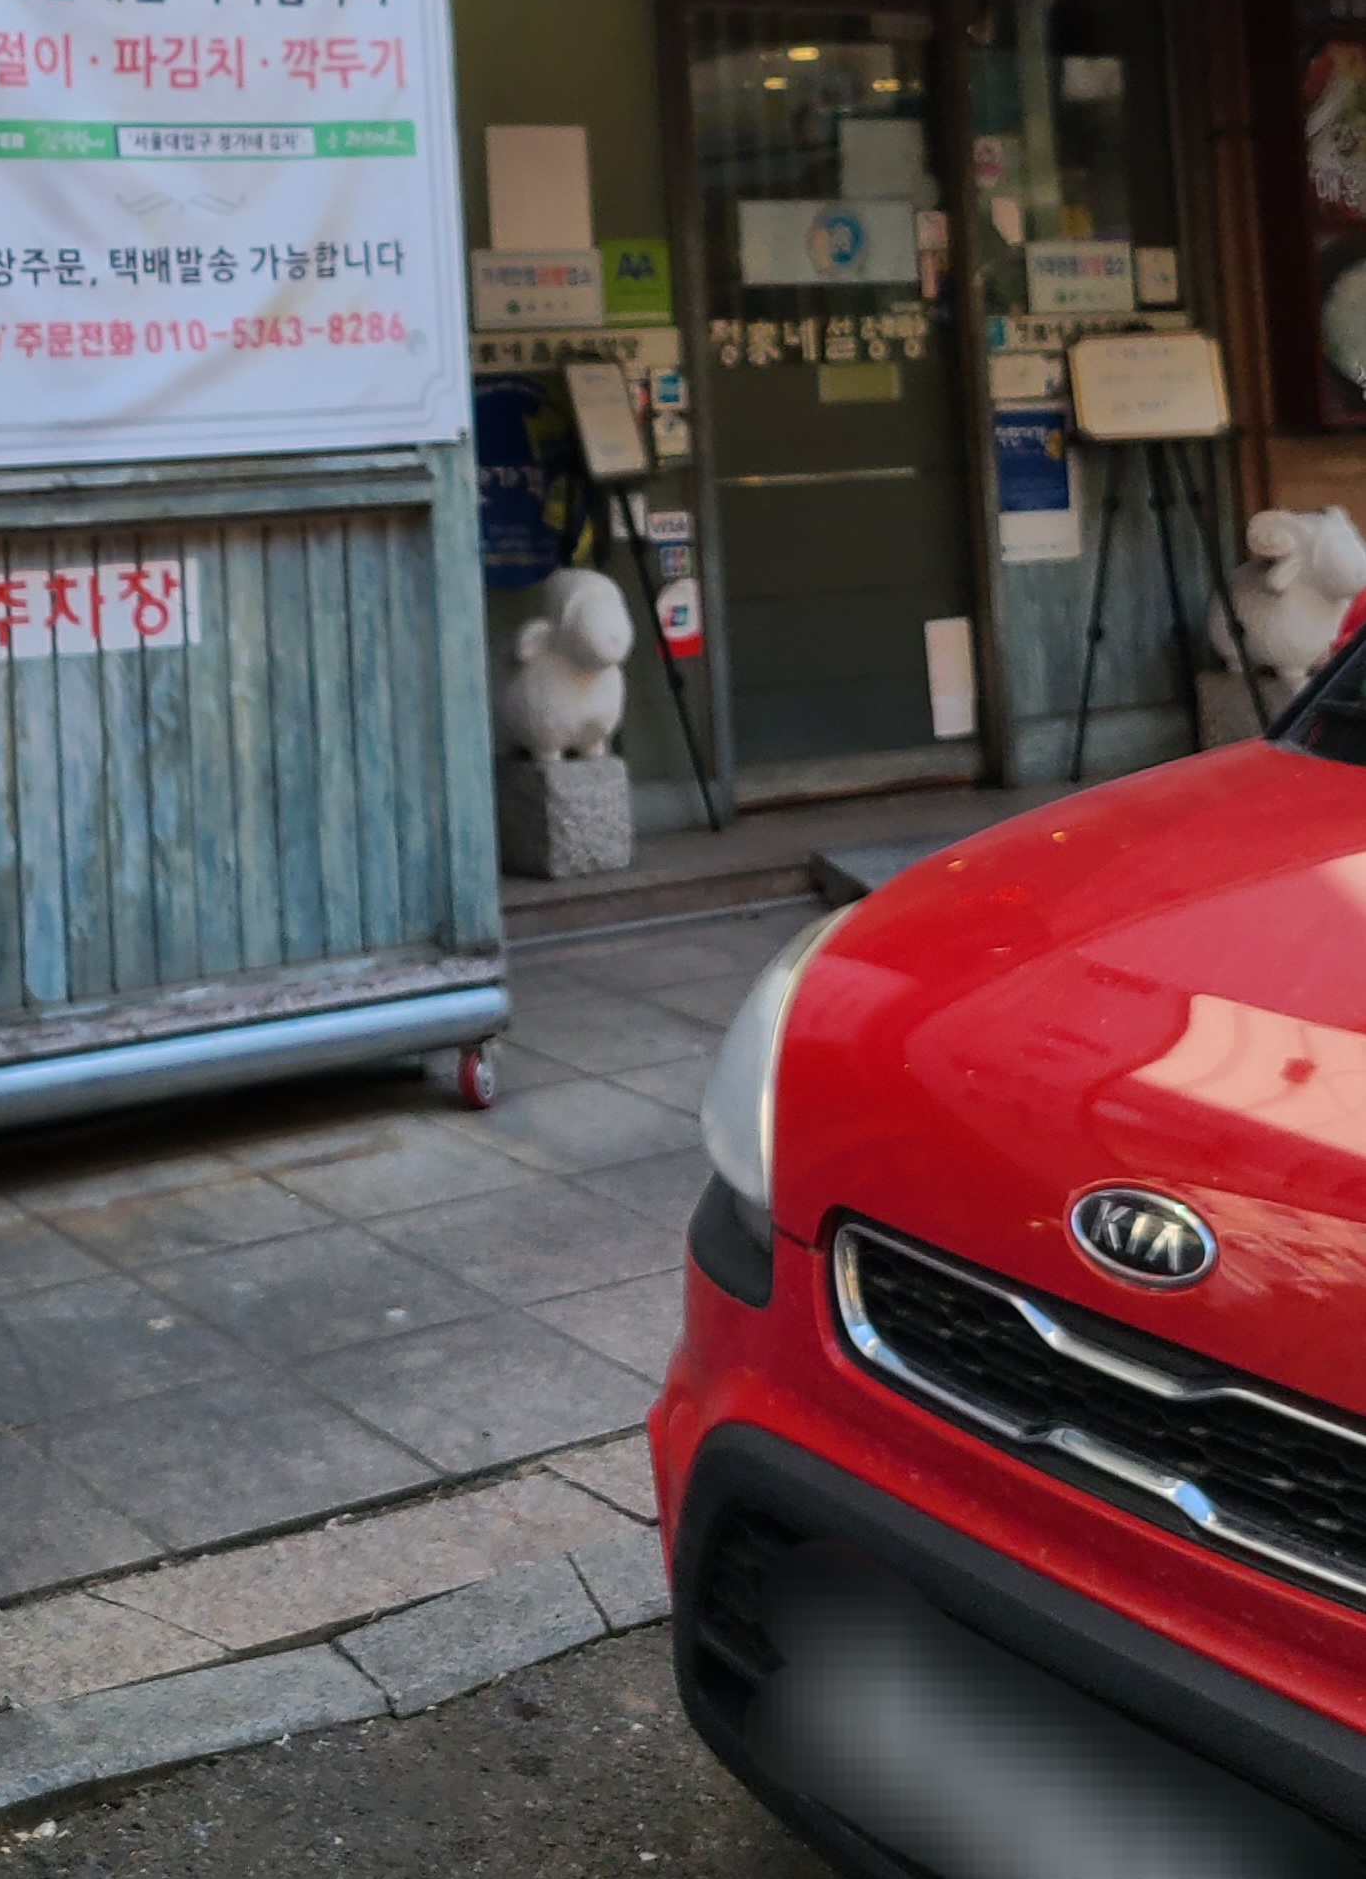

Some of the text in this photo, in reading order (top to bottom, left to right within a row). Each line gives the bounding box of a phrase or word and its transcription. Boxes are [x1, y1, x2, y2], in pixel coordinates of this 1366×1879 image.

[113, 34, 245, 91] 파김치
[109, 245, 238, 285] 택배발송
[251, 240, 405, 281] 가능합니다
[14, 310, 406, 359] 주문전화 010-5343-8286
[1090, 1199, 1183, 1273] KIA
